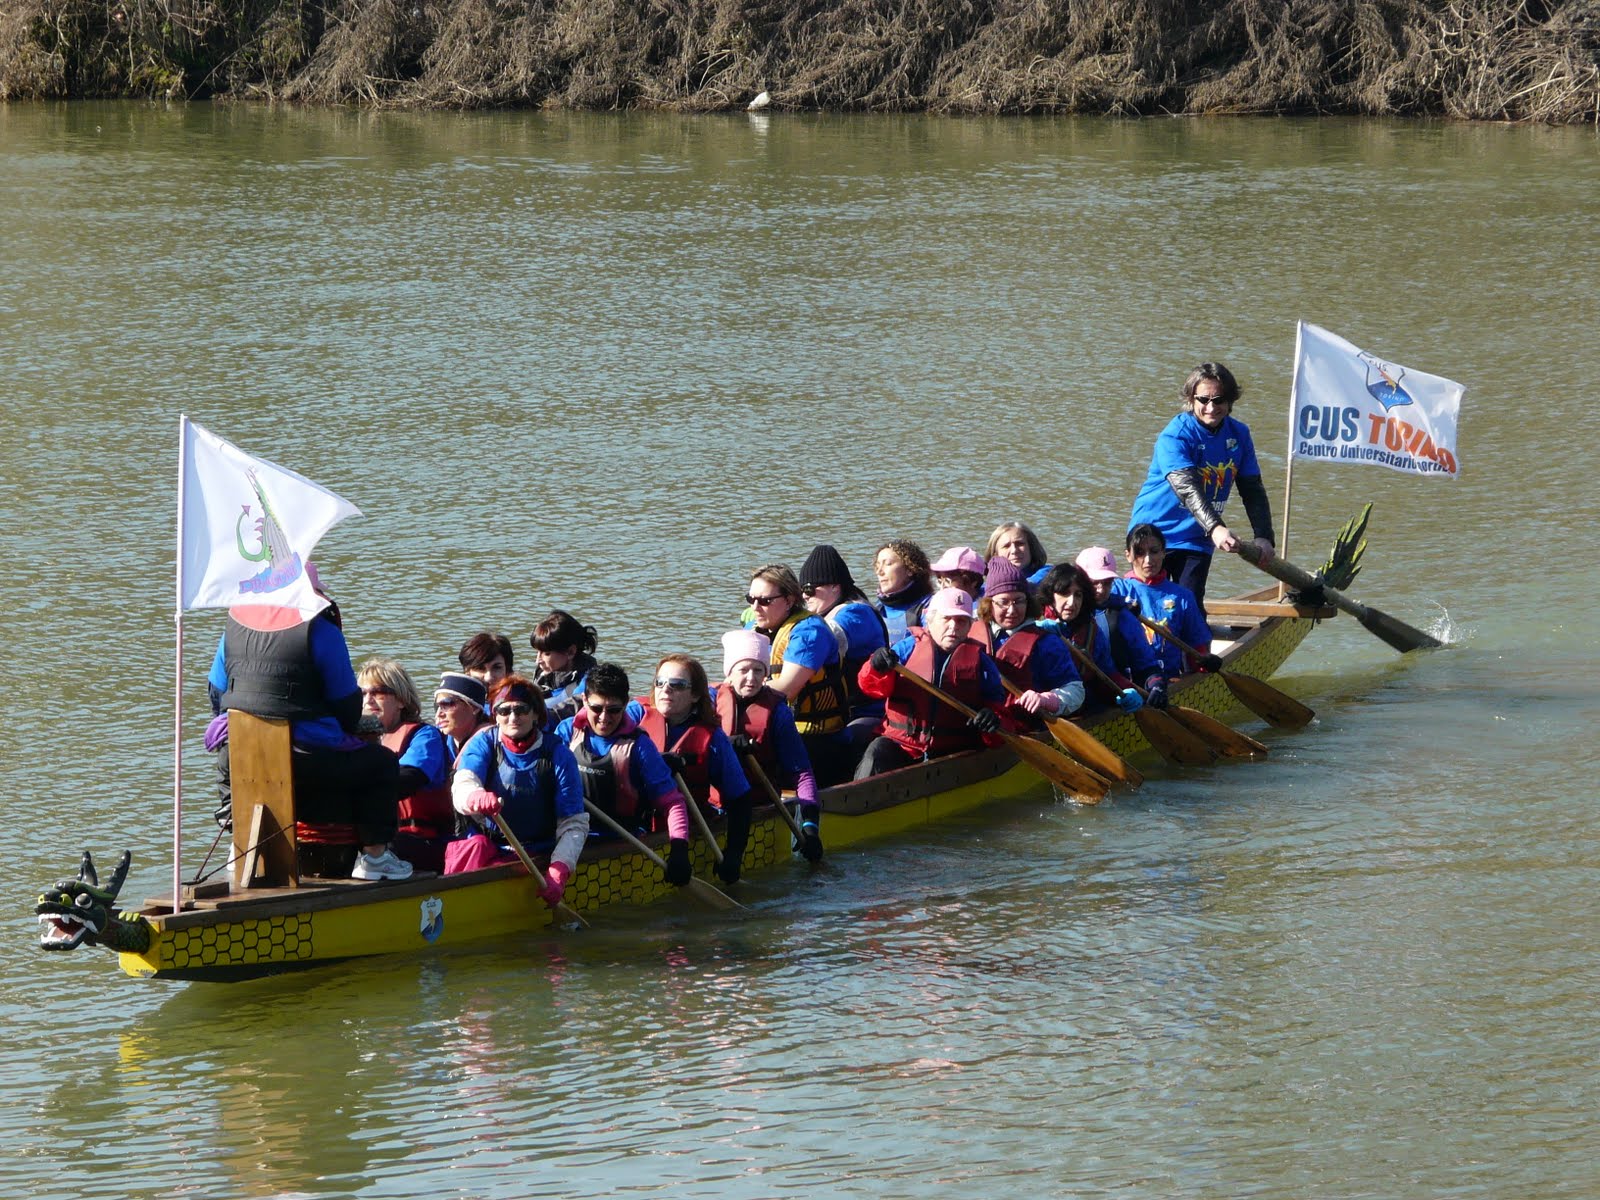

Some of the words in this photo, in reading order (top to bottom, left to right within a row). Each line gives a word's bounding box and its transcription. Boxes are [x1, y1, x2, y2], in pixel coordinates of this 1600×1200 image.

[1299, 404, 1360, 442] CUS
[1299, 441, 1338, 458] Centro
[1340, 444, 1416, 470] Universitario
